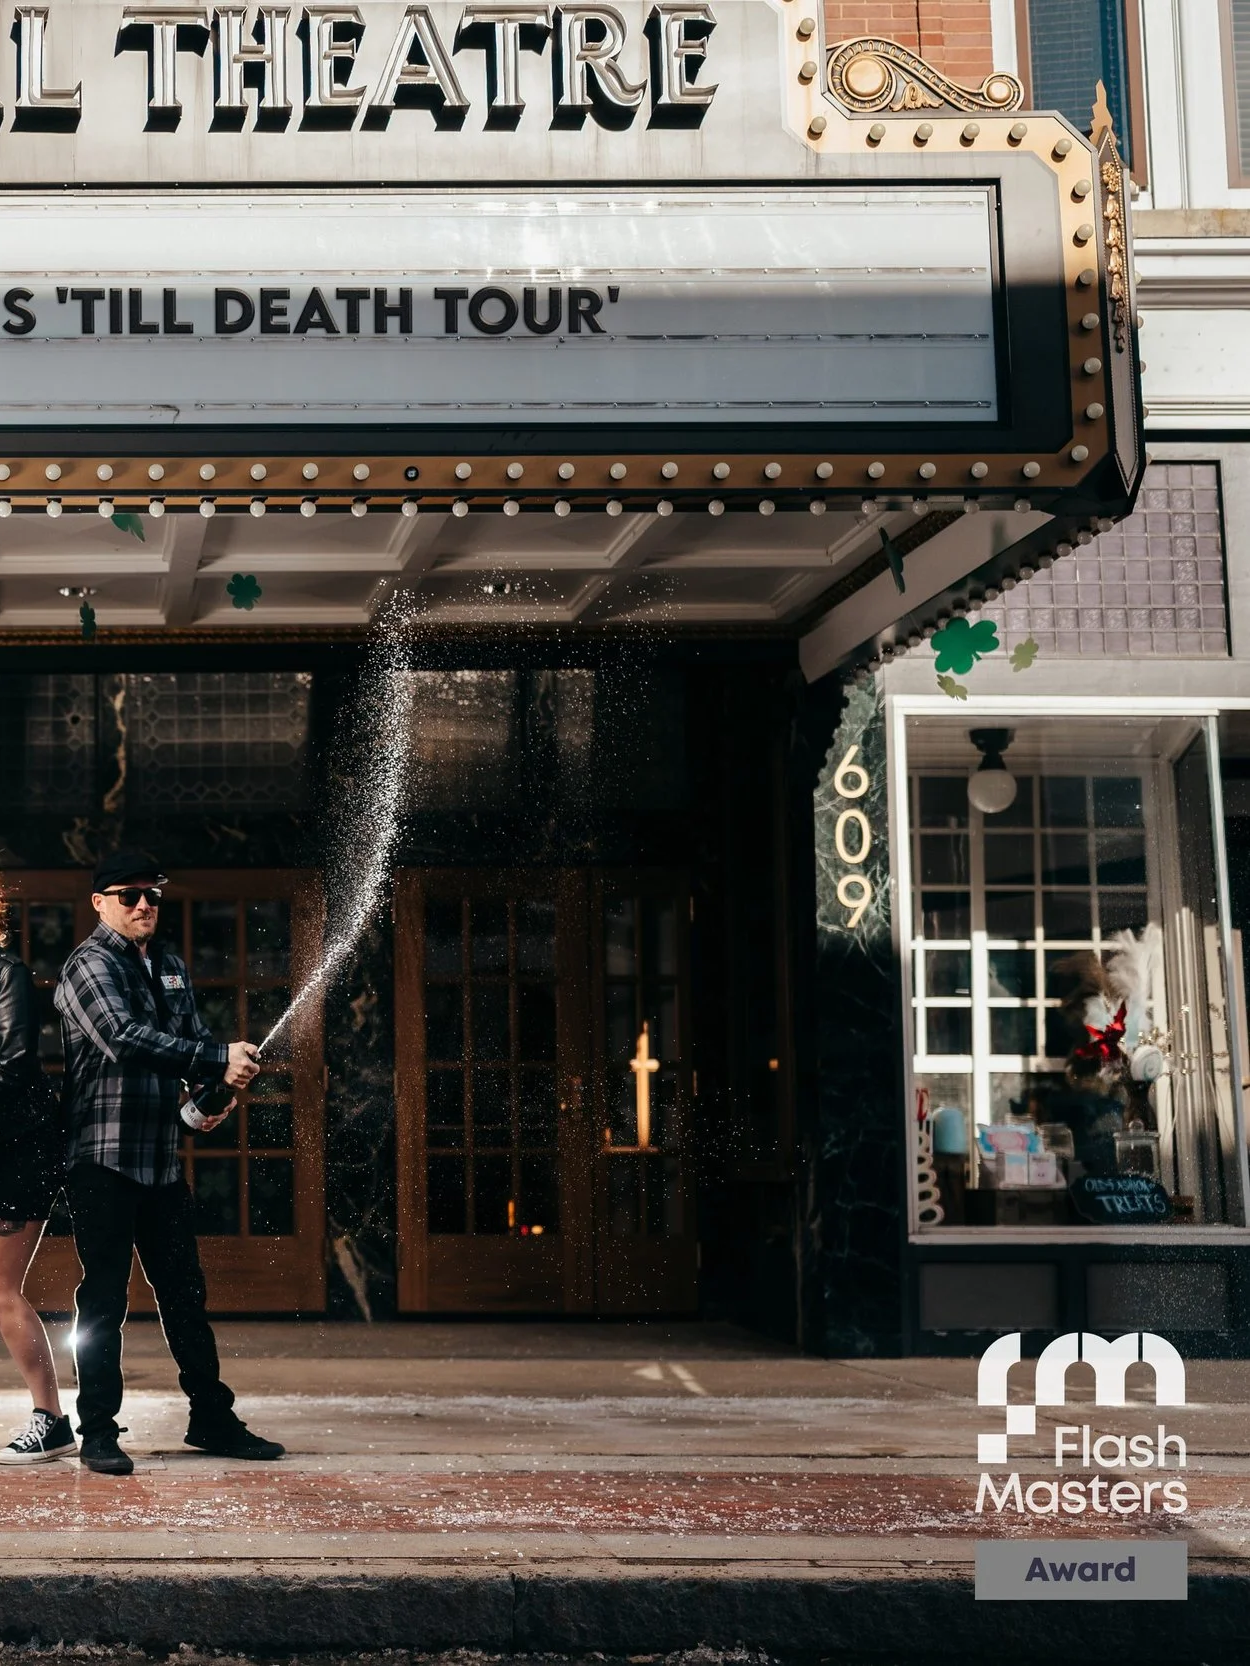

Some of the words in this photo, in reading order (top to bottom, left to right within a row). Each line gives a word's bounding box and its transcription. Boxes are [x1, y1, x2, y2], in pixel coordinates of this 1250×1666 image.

[120, 3, 720, 116] THEATRE
[56, 286, 194, 335] 'TILL
[214, 286, 414, 335] DEATH
[434, 285, 620, 335] TOUR'
[1094, 1194, 1167, 1214] TREATS
